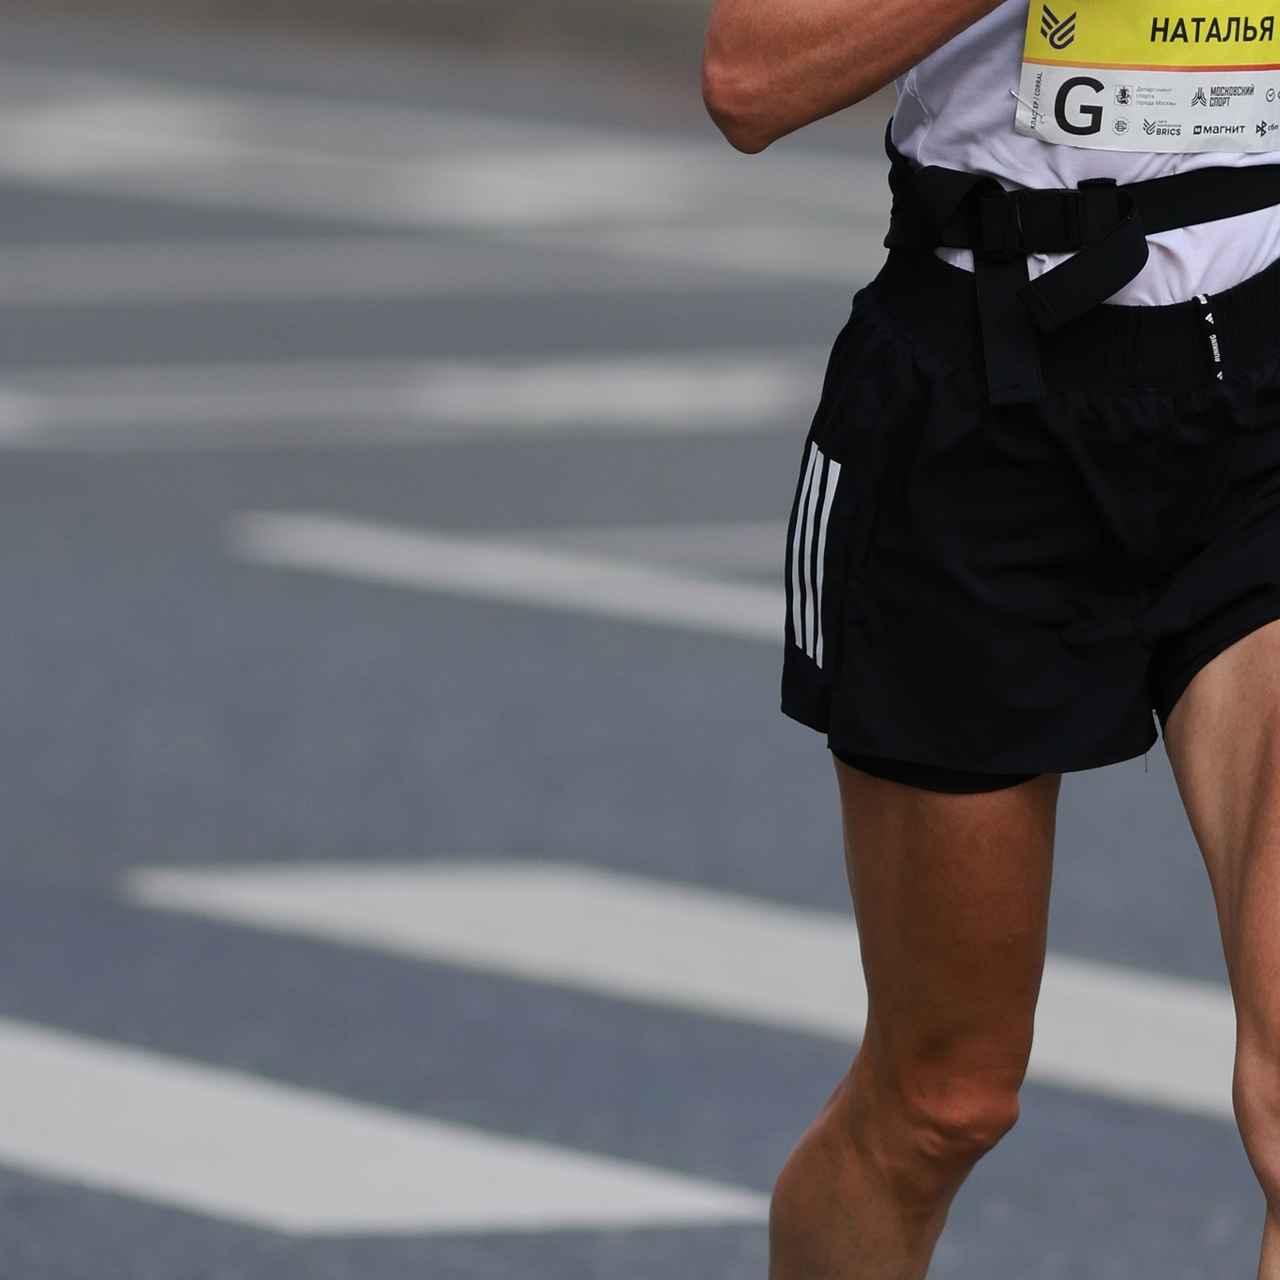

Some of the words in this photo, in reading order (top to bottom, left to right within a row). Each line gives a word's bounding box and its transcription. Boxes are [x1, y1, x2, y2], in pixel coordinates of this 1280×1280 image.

[1150, 16, 1275, 43] НАТАЛЬЯ
[1210, 83, 1255, 97] МОСКОВСКИЙ
[1054, 76, 1105, 136] G
[1209, 97, 1231, 107] СПОРТ
[1156, 128, 1181, 136] BRICS
[1209, 334, 1221, 362] RUNNING
